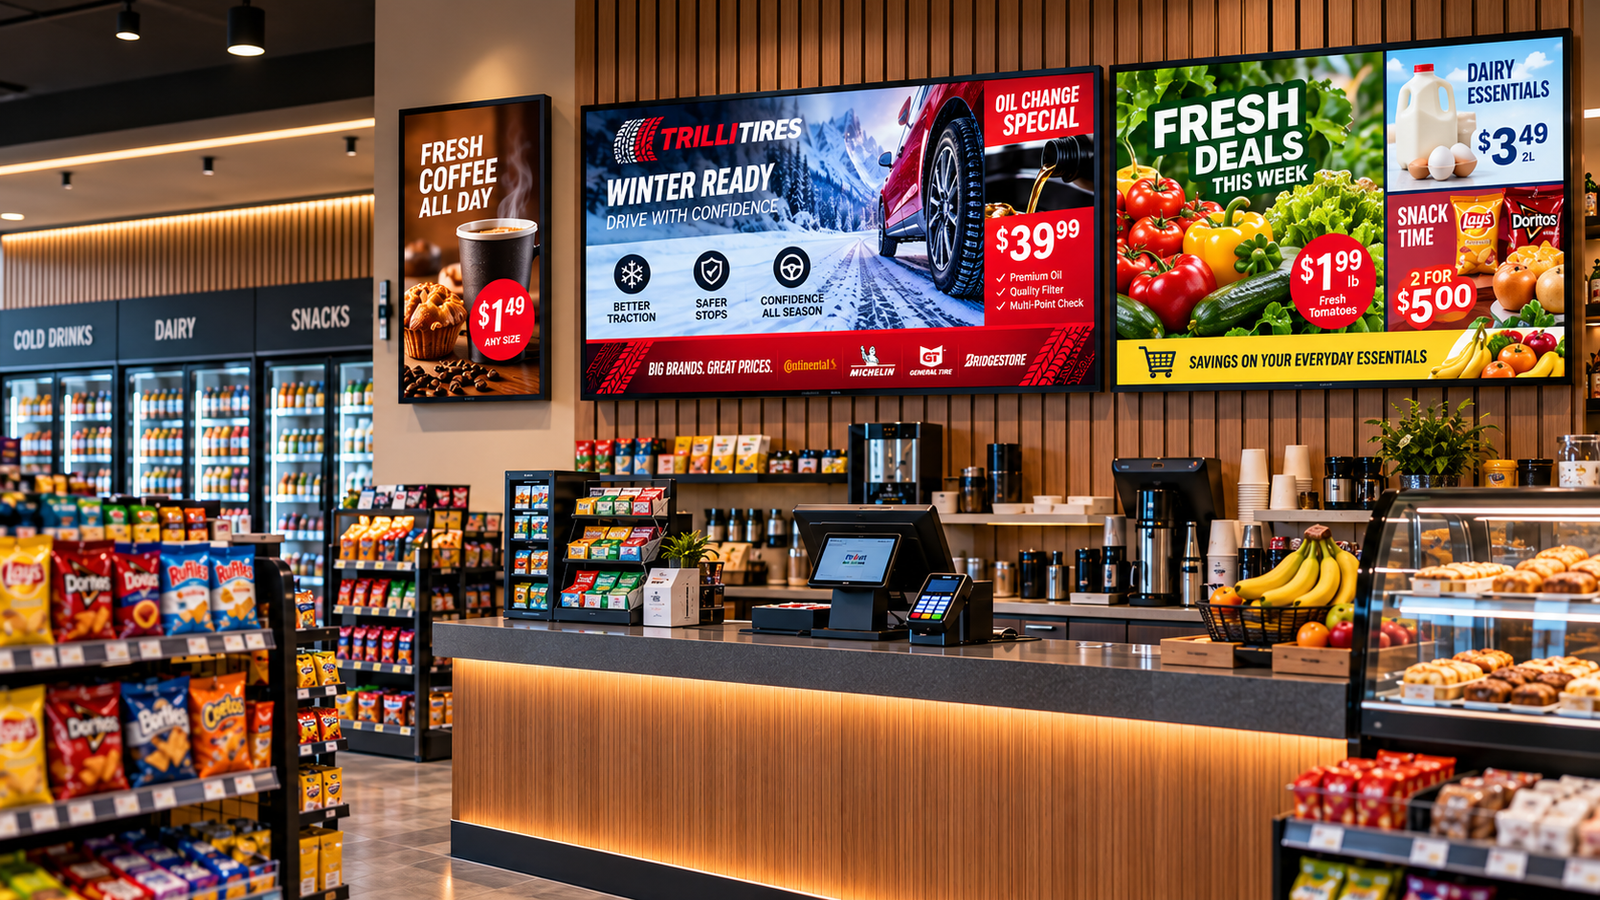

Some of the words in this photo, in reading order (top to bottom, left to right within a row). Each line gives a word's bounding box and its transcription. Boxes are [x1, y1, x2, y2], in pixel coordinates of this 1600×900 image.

[1467, 59, 1515, 83] DAIRY
[995, 94, 1018, 114] OIL
[1021, 85, 1080, 110] CHANGE
[1467, 80, 1550, 105] ESSENTIALS
[1002, 106, 1080, 137] SPECIAL
[1154, 87, 1299, 149] FRESH
[660, 118, 803, 151] TRILLITIRES
[420, 134, 484, 166] FRESH
[1195, 131, 1304, 176] DEALS
[1521, 152, 1536, 163] 2L
[418, 157, 499, 195] COFFEE
[606, 171, 696, 207] WINTER
[700, 162, 776, 198] READY
[1211, 172, 1253, 195] THIS
[1257, 163, 1309, 189] WEEK
[418, 195, 452, 219] ALL
[456, 186, 494, 212] DAY
[606, 212, 648, 231] DRIVE
[651, 207, 688, 226] WITH
[691, 198, 779, 222] CONFIDENCE
[1397, 203, 1449, 227] SNACK
[1512, 213, 1557, 229] Doritos
[1398, 227, 1435, 248] TIME
[1010, 272, 1049, 282] Premium
[1050, 271, 1063, 281] Oil
[1347, 275, 1360, 288] lb
[1410, 271, 1421, 287] 2
[1423, 269, 1453, 285] FOR
[1010, 286, 1039, 297] Quality
[1041, 285, 1064, 295] Filter
[1319, 293, 1347, 306] Fresh
[613, 301, 651, 312] BETTER
[695, 298, 728, 309] SAFER
[760, 294, 825, 306] CONFIDENCE
[1010, 300, 1056, 311] Multi-Point
[1057, 298, 1085, 309] Check
[290, 305, 350, 332] SNACKS
[607, 312, 656, 323] TRACTION
[695, 310, 728, 320] STOPS
[762, 308, 781, 318] ALL
[783, 306, 823, 317] SEASON
[1309, 304, 1358, 318] Tomatoes
[13, 329, 46, 351] COLD
[48, 324, 93, 349] DRINKS
[155, 317, 196, 341] DAIRY
[502, 334, 521, 345] SIZE
[922, 352, 940, 363] GT
[964, 353, 1028, 368] BRIDGESTORE
[1189, 354, 1238, 369] SAVINGS
[1241, 354, 1258, 368] ON
[1260, 353, 1292, 368] YOUR
[1294, 352, 1354, 367] EVERYDAY
[1356, 350, 1428, 365] ESSENTIALS
[648, 362, 664, 376] BIG
[665, 360, 706, 375] BRANDS.
[707, 360, 737, 375] GREAT
[738, 359, 773, 374] PRICES.
[784, 359, 830, 374] Continental
[850, 367, 896, 377] MICHELIN
[938, 368, 953, 376] TIRE
